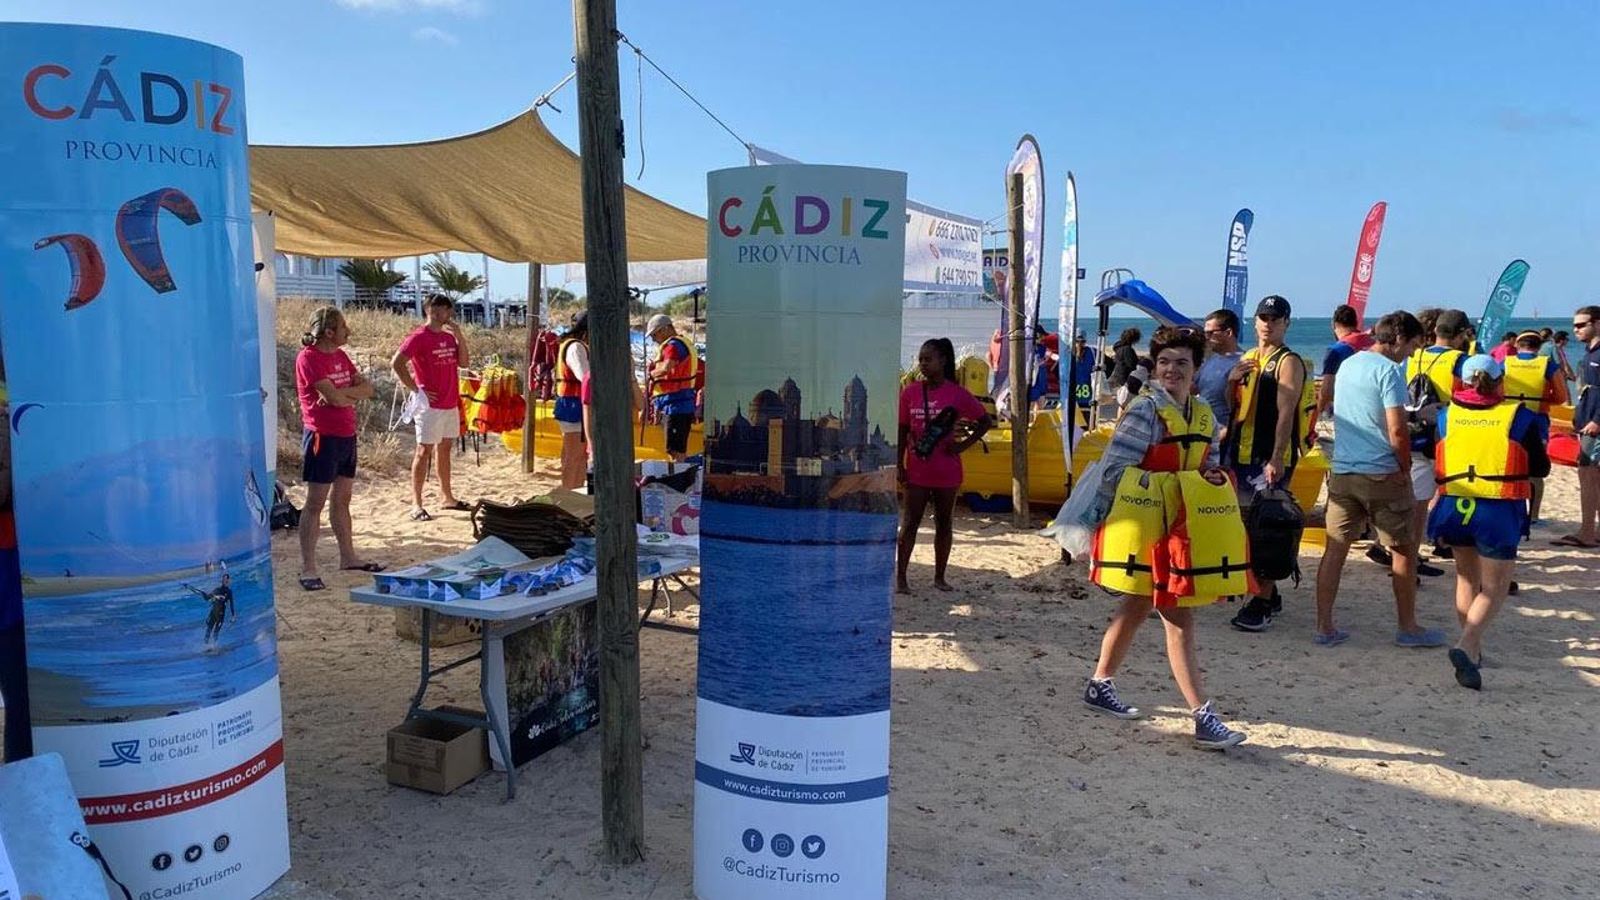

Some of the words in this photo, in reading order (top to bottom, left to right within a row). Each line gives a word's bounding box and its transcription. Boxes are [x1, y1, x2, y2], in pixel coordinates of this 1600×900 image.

[23, 55, 235, 136] CÁDIZ
[65, 140, 218, 169] PROVINCIA
[718, 185, 890, 240] CÁDIZ
[738, 244, 862, 265] PROVINCIA
[1229, 221, 1247, 266] NSP
[1075, 384, 1090, 399] 48
[1455, 497, 1477, 526] 9
[148, 728, 209, 748] Diputación
[150, 751, 165, 762] de
[168, 745, 199, 760] Cádiz
[758, 760, 768, 769] de
[770, 760, 795, 772] Cádiz
[759, 746, 804, 761] Diputación
[83, 757, 268, 816] www.cadizturismo.com
[723, 778, 847, 800] www.cadizturismo.com
[723, 856, 840, 884] @CadizTurismo
